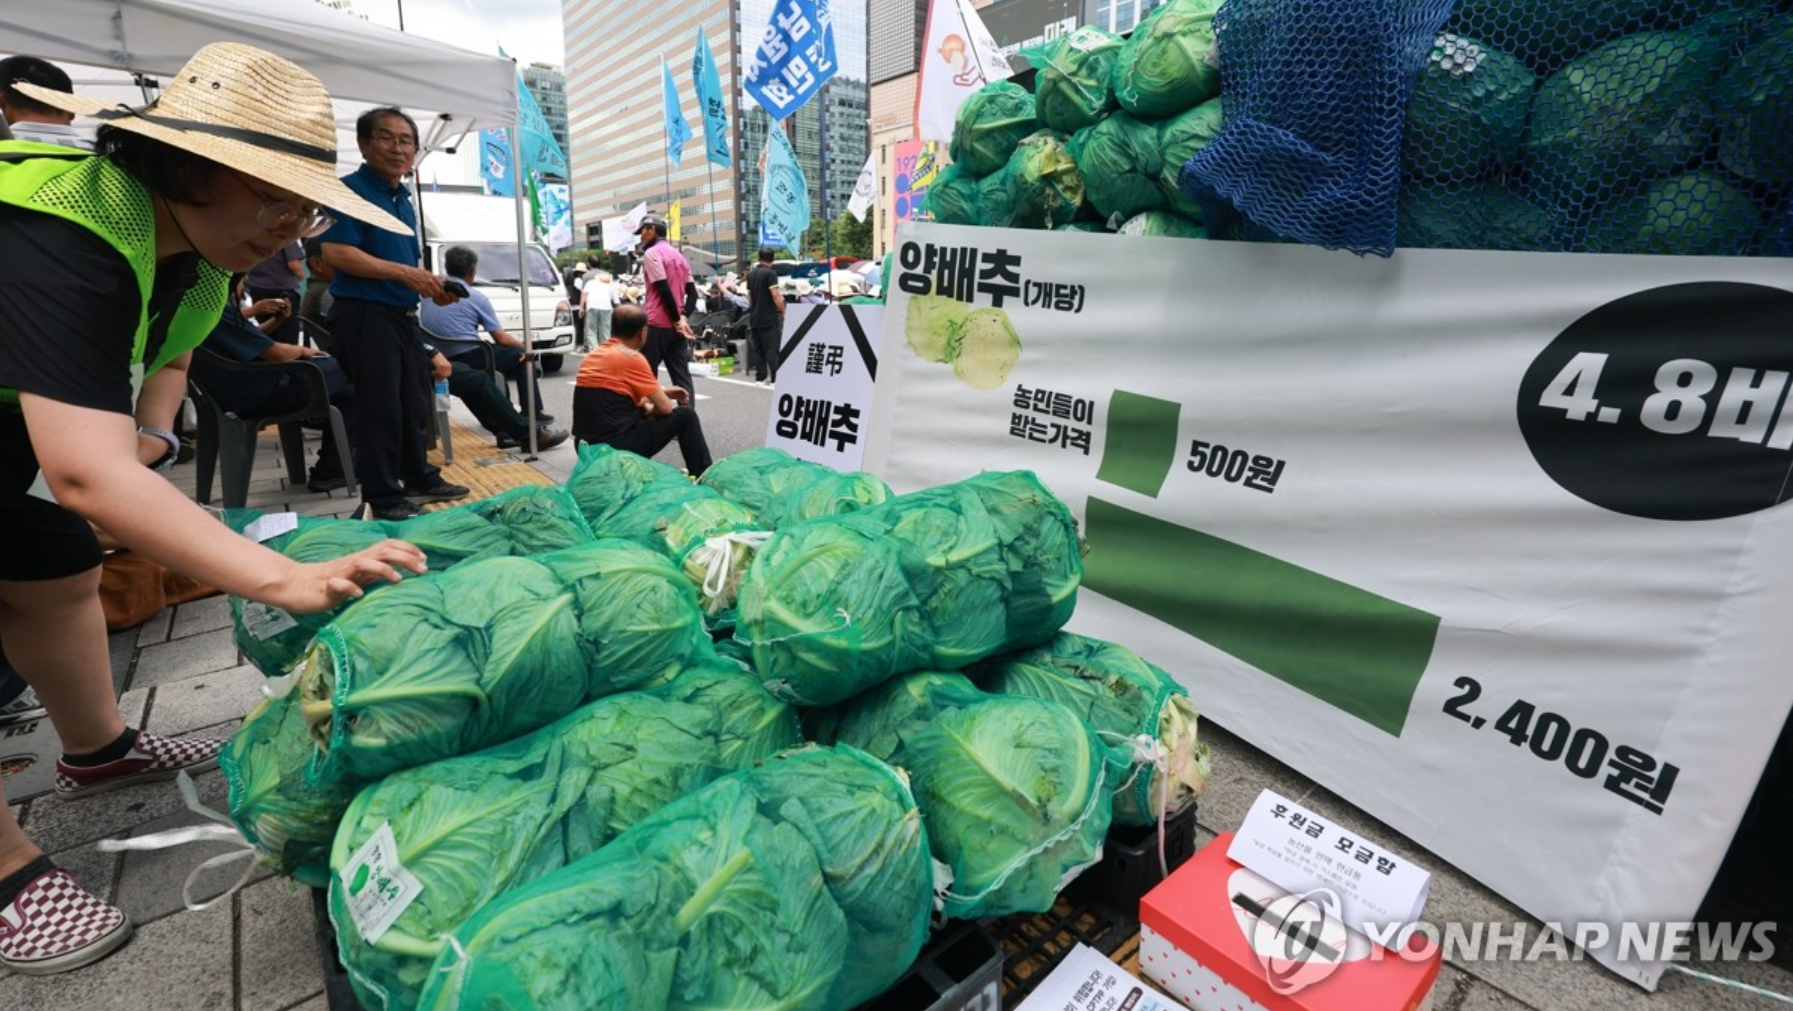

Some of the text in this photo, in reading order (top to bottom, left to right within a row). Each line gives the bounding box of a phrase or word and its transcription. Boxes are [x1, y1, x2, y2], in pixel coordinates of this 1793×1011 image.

[899, 241, 1085, 313] 양배추 (개당)
[775, 393, 861, 453] 양배추
[1009, 412, 1092, 456] 받는가격
[1013, 384, 1095, 425] 농민들이
[1187, 439, 1286, 494] 500원
[1442, 676, 1681, 816] 2,400원
[1270, 803, 1397, 876] 후원금 모금함
